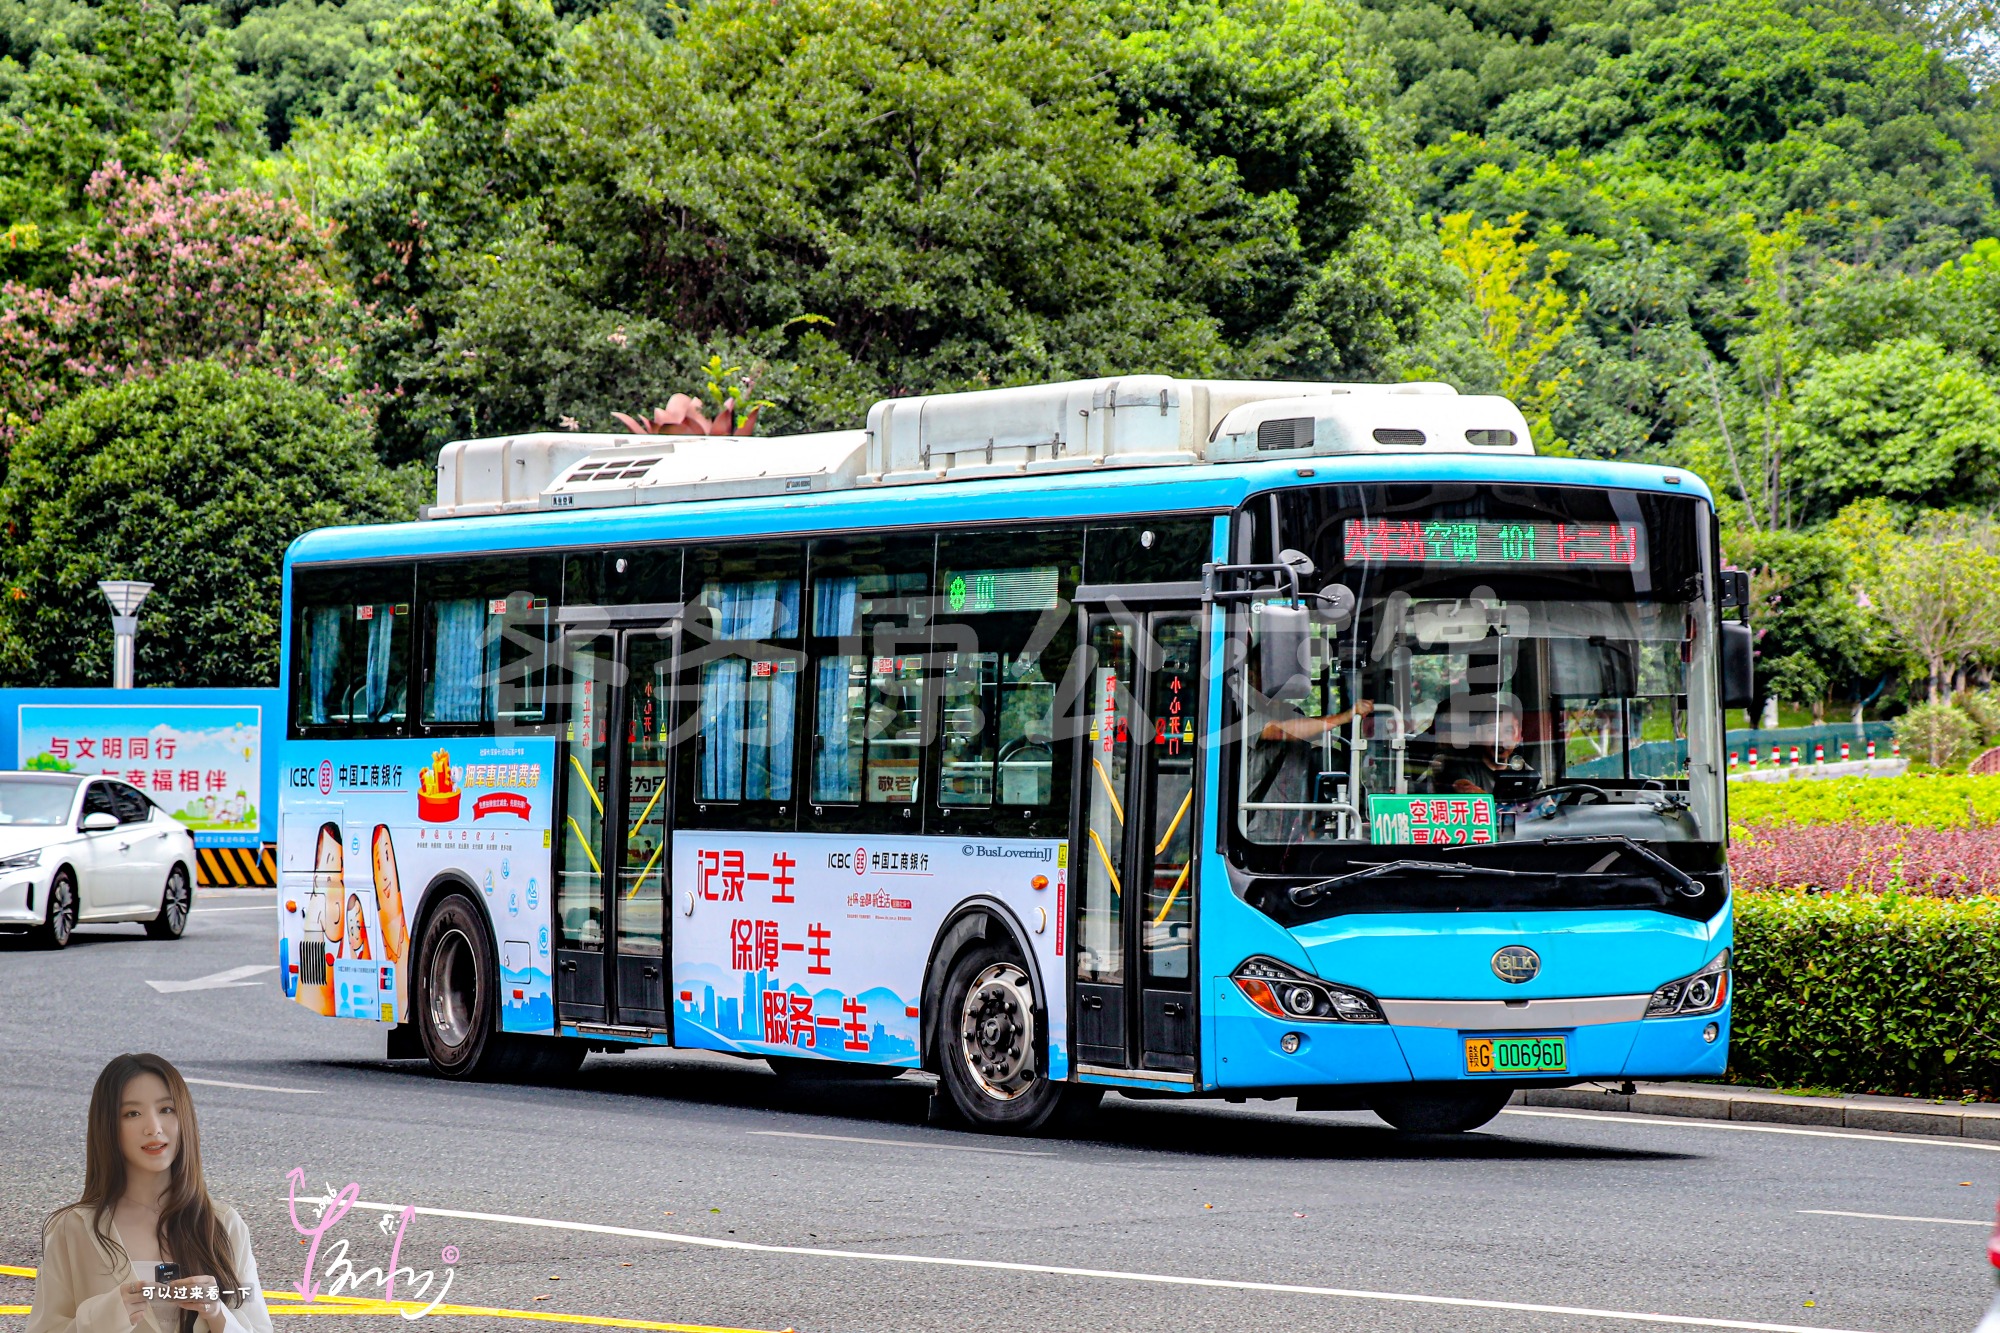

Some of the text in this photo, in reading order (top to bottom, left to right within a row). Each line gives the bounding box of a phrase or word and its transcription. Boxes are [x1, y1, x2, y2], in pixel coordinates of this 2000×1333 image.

[1344, 520, 1478, 562] 火车站 空调
[1499, 524, 1536, 560] 101
[49, 737, 176, 759] 与文明同行
[289, 768, 315, 787] ICBC
[339, 764, 402, 787] 中国工商银行
[464, 764, 540, 788] 拥军惠民消费券
[1409, 800, 1490, 825] 空调开启
[1411, 828, 1491, 844] 票价2元
[828, 853, 851, 868] ICBC
[872, 852, 929, 871] 中国工商银行
[697, 849, 796, 903] 记录一生
[730, 919, 831, 974] 保障一生
[1500, 956, 1534, 970] BLK
[762, 991, 869, 1051] 服务一生
[1499, 1043, 1563, 1066] 00696D
